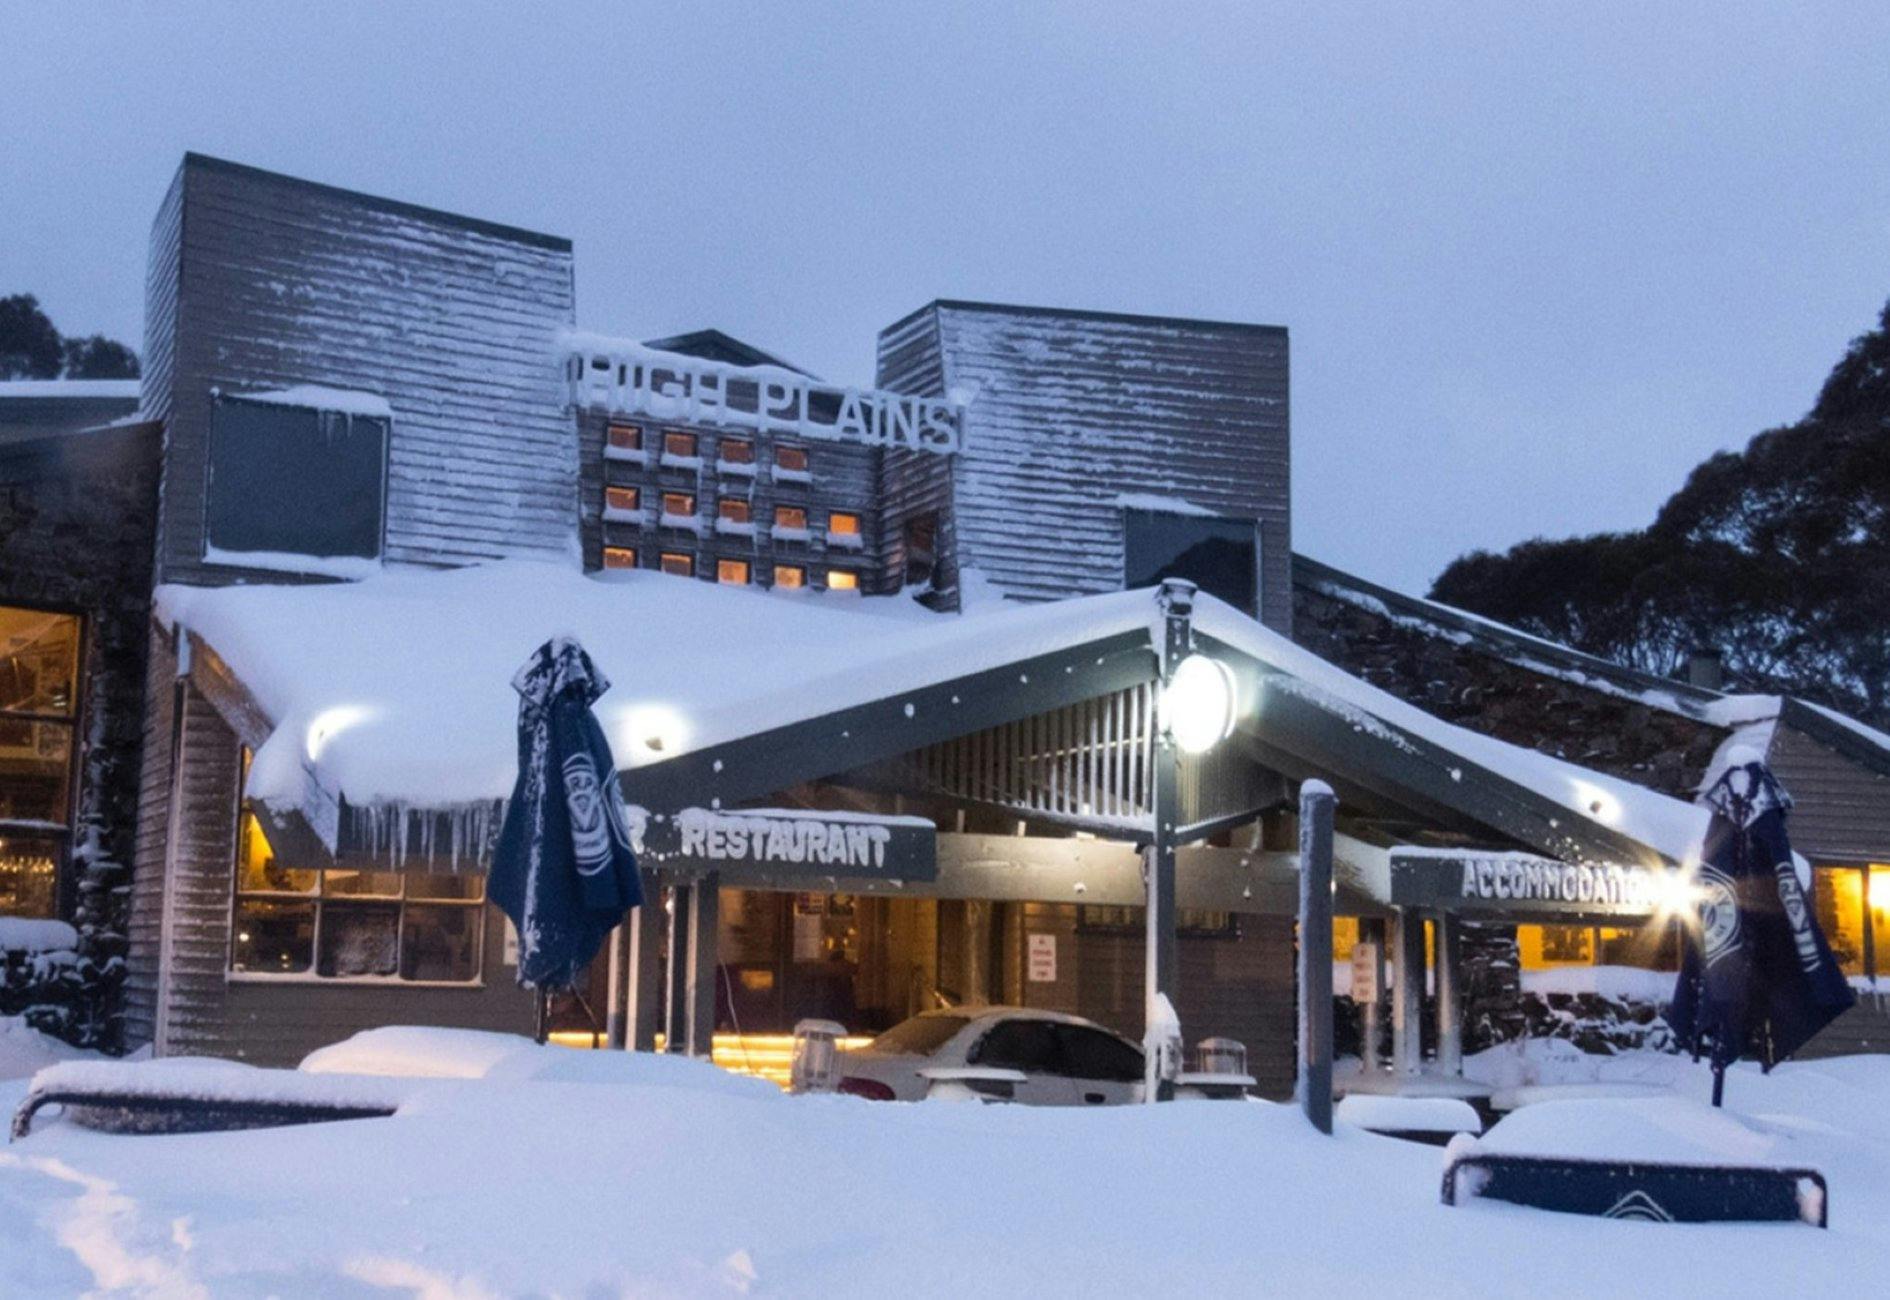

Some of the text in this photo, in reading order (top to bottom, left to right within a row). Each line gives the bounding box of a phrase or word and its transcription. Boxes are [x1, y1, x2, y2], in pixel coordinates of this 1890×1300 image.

[580, 347, 960, 453] HIGH PLAINS
[680, 809, 890, 868] RESTAURANT
[1462, 858, 1662, 904] ACCOMMODATI
